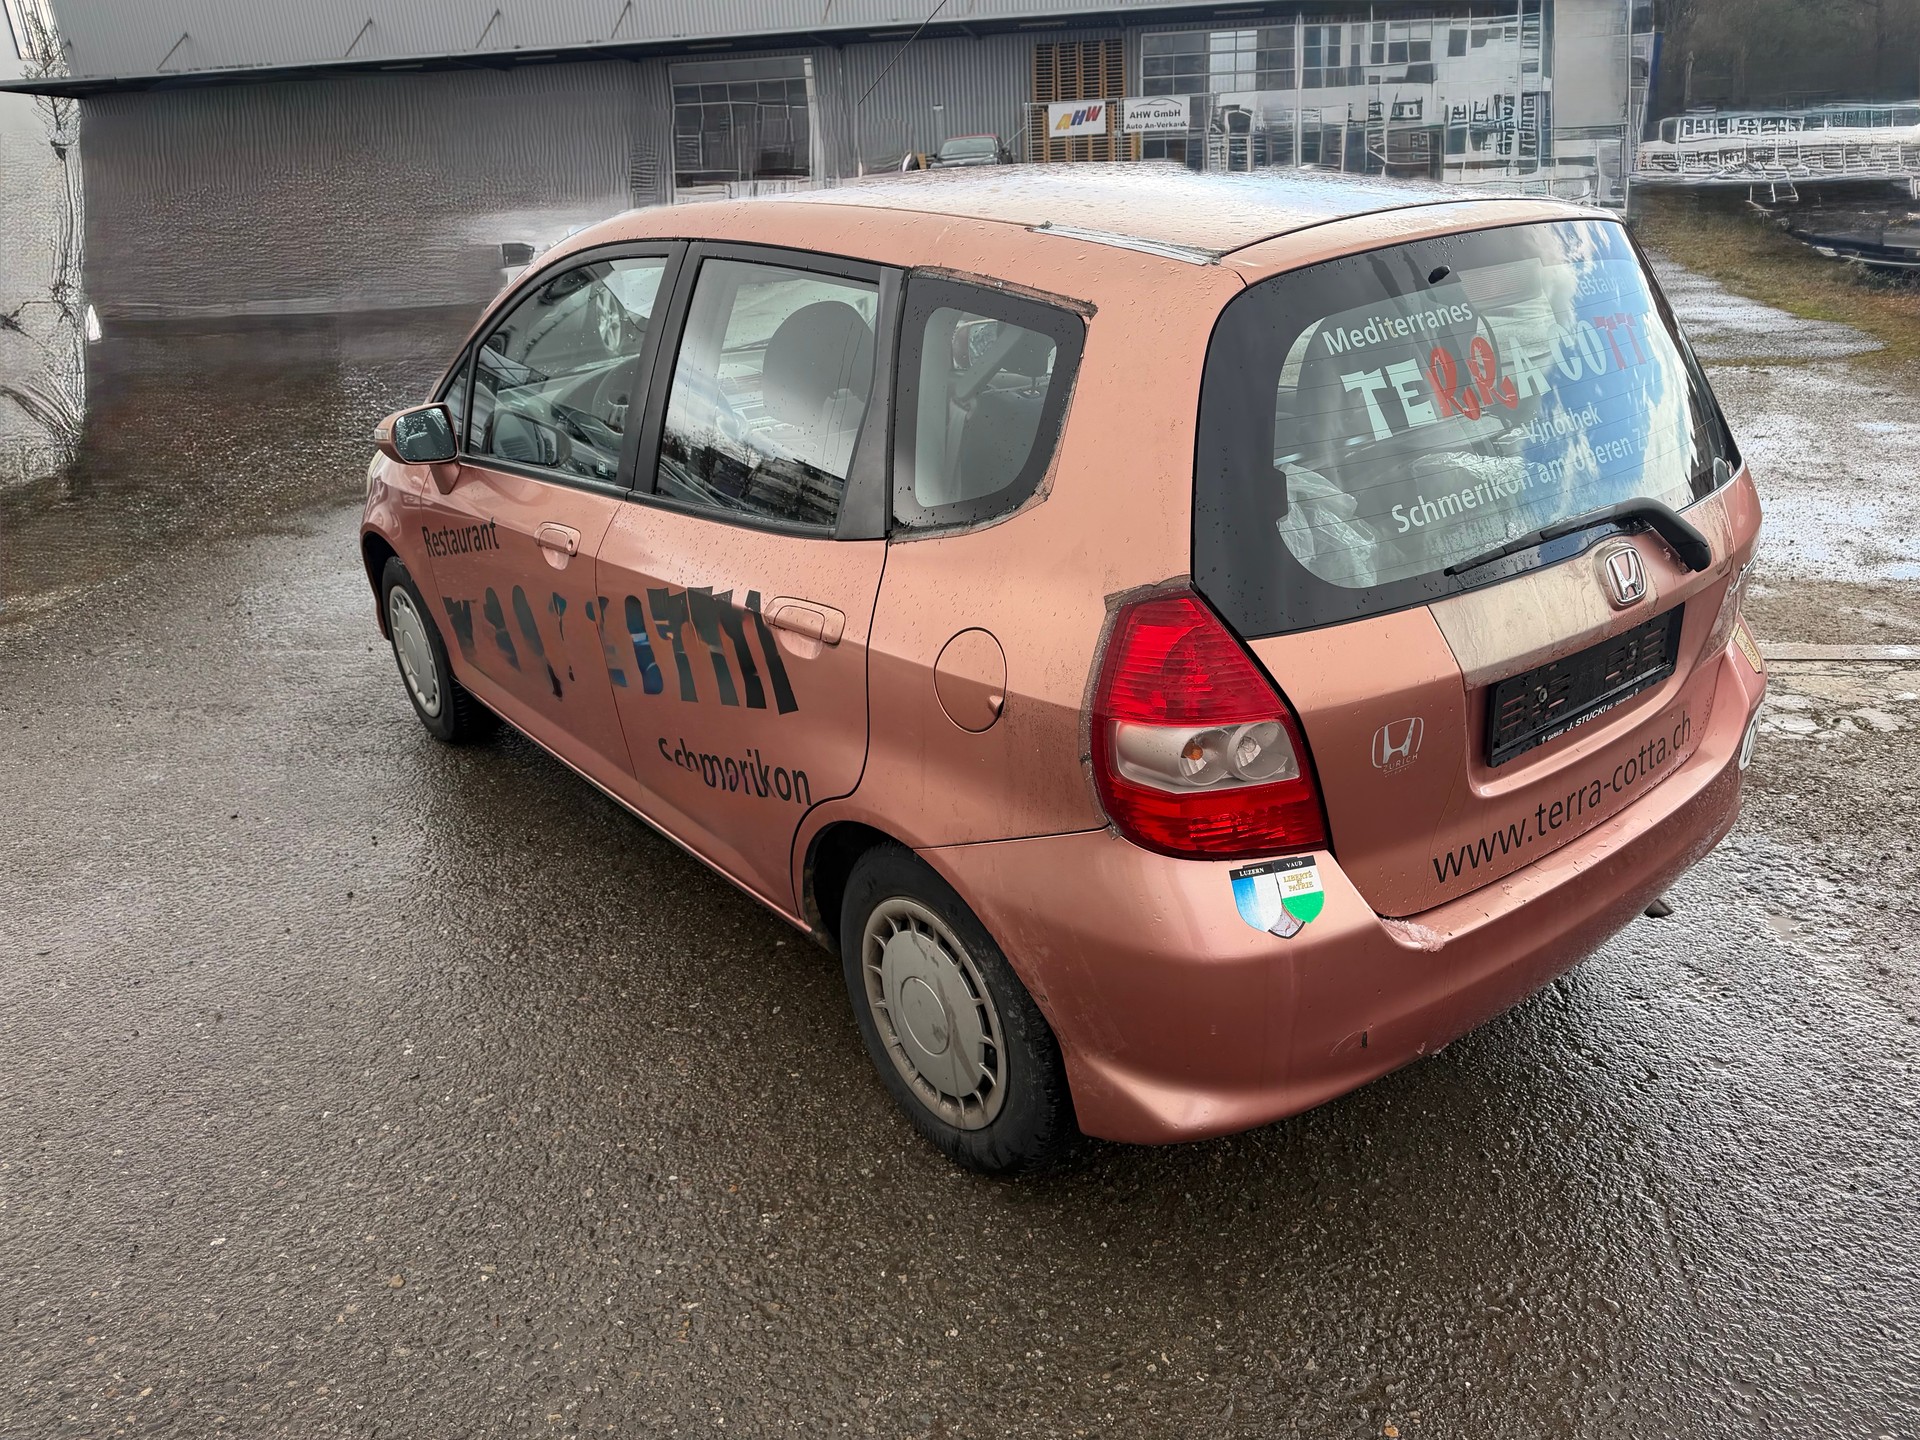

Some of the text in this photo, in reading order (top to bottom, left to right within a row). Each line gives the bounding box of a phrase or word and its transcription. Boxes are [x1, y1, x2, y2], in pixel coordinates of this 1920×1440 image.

[1055, 105, 1103, 131] AHW
[1129, 109, 1181, 119] AHW GmbH
[1322, 302, 1473, 356] Mediterranes
[1340, 335, 1552, 442] TERRA
[1523, 402, 1603, 444] Vinothek
[1391, 468, 1534, 534] Schmerikon
[1539, 459, 1565, 485] am
[1573, 436, 1634, 473] oberen
[421, 516, 500, 558] Restaurant
[1575, 704, 1607, 727] STUCKI
[1432, 710, 1692, 884] www.terra-cotta.ch
[1239, 867, 1265, 877] LUZERN
[1286, 860, 1303, 868] VAUD
[1288, 881, 1314, 892] PATRIE
